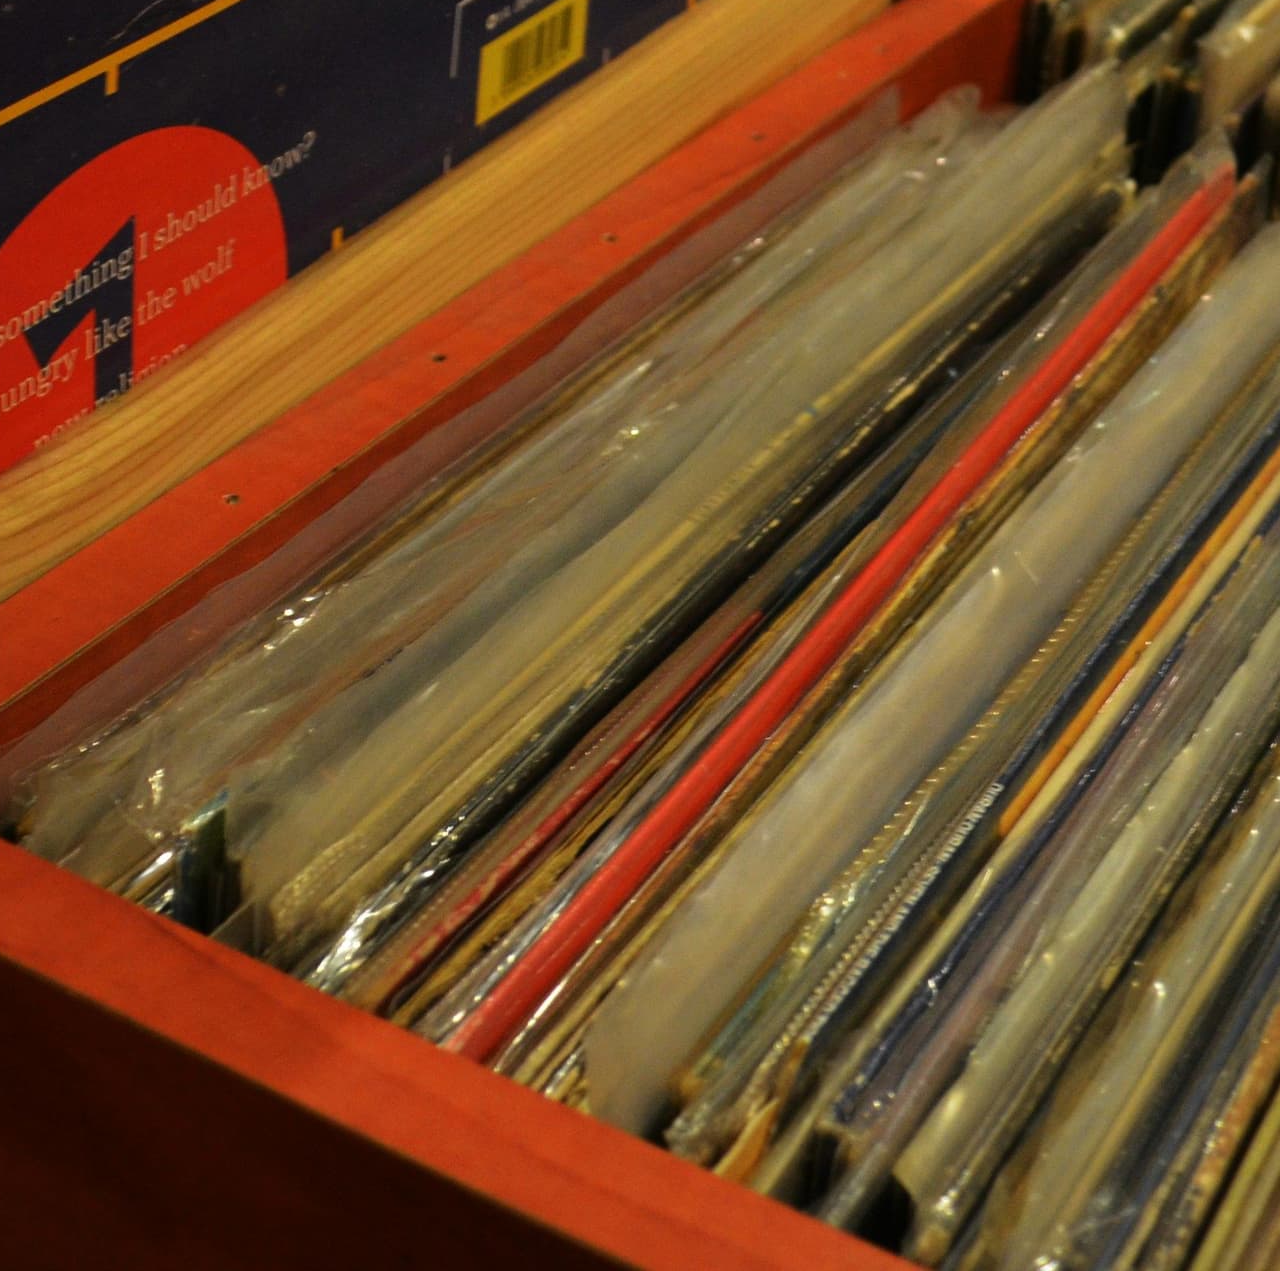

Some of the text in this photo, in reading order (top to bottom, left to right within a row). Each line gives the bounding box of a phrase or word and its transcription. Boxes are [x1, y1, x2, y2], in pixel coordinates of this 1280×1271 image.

[138, 231, 149, 261] I
[153, 174, 238, 253] should
[241, 130, 317, 198] know?
[84, 315, 132, 361] like
[136, 286, 178, 326] the
[180, 237, 237, 297] wolf
